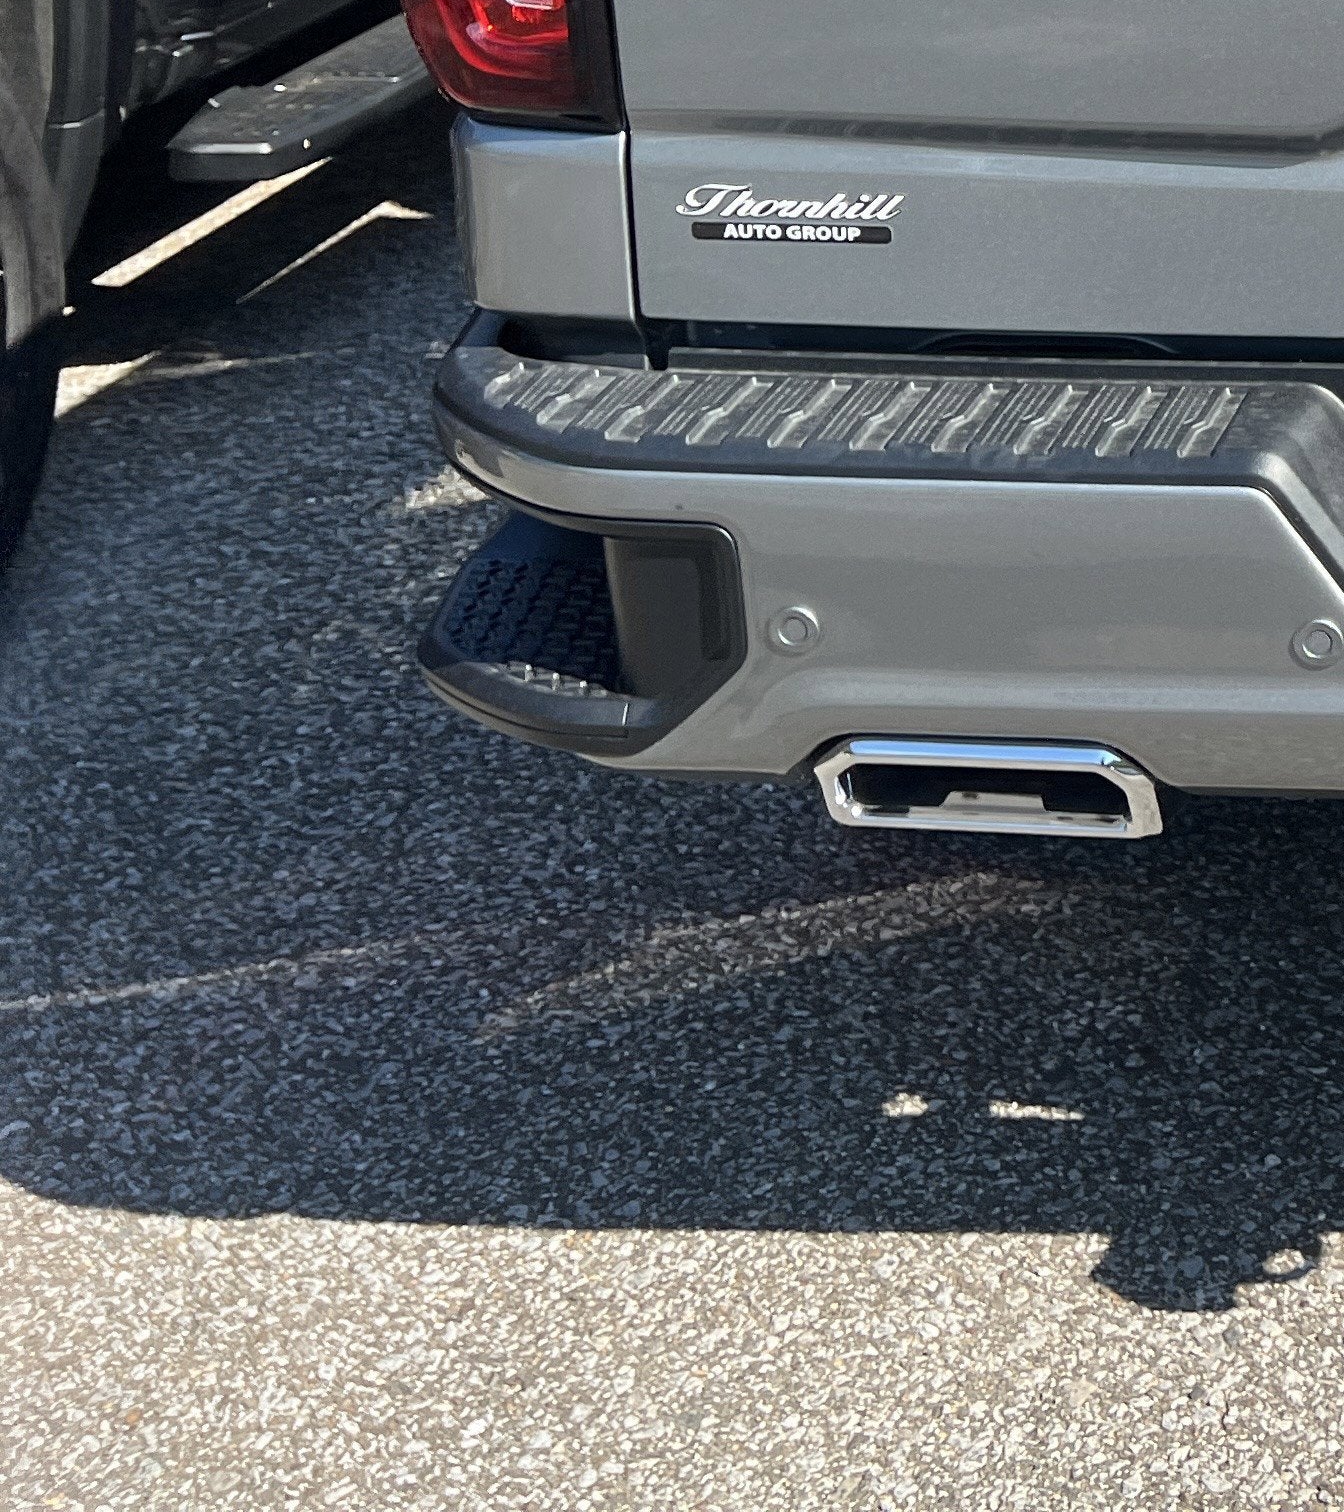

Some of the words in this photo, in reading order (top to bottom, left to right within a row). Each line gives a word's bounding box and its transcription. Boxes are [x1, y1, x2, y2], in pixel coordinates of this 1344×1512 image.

[675, 182, 905, 221] Thornhill
[723, 223, 782, 240] AUTO
[785, 225, 861, 242] GROUP
